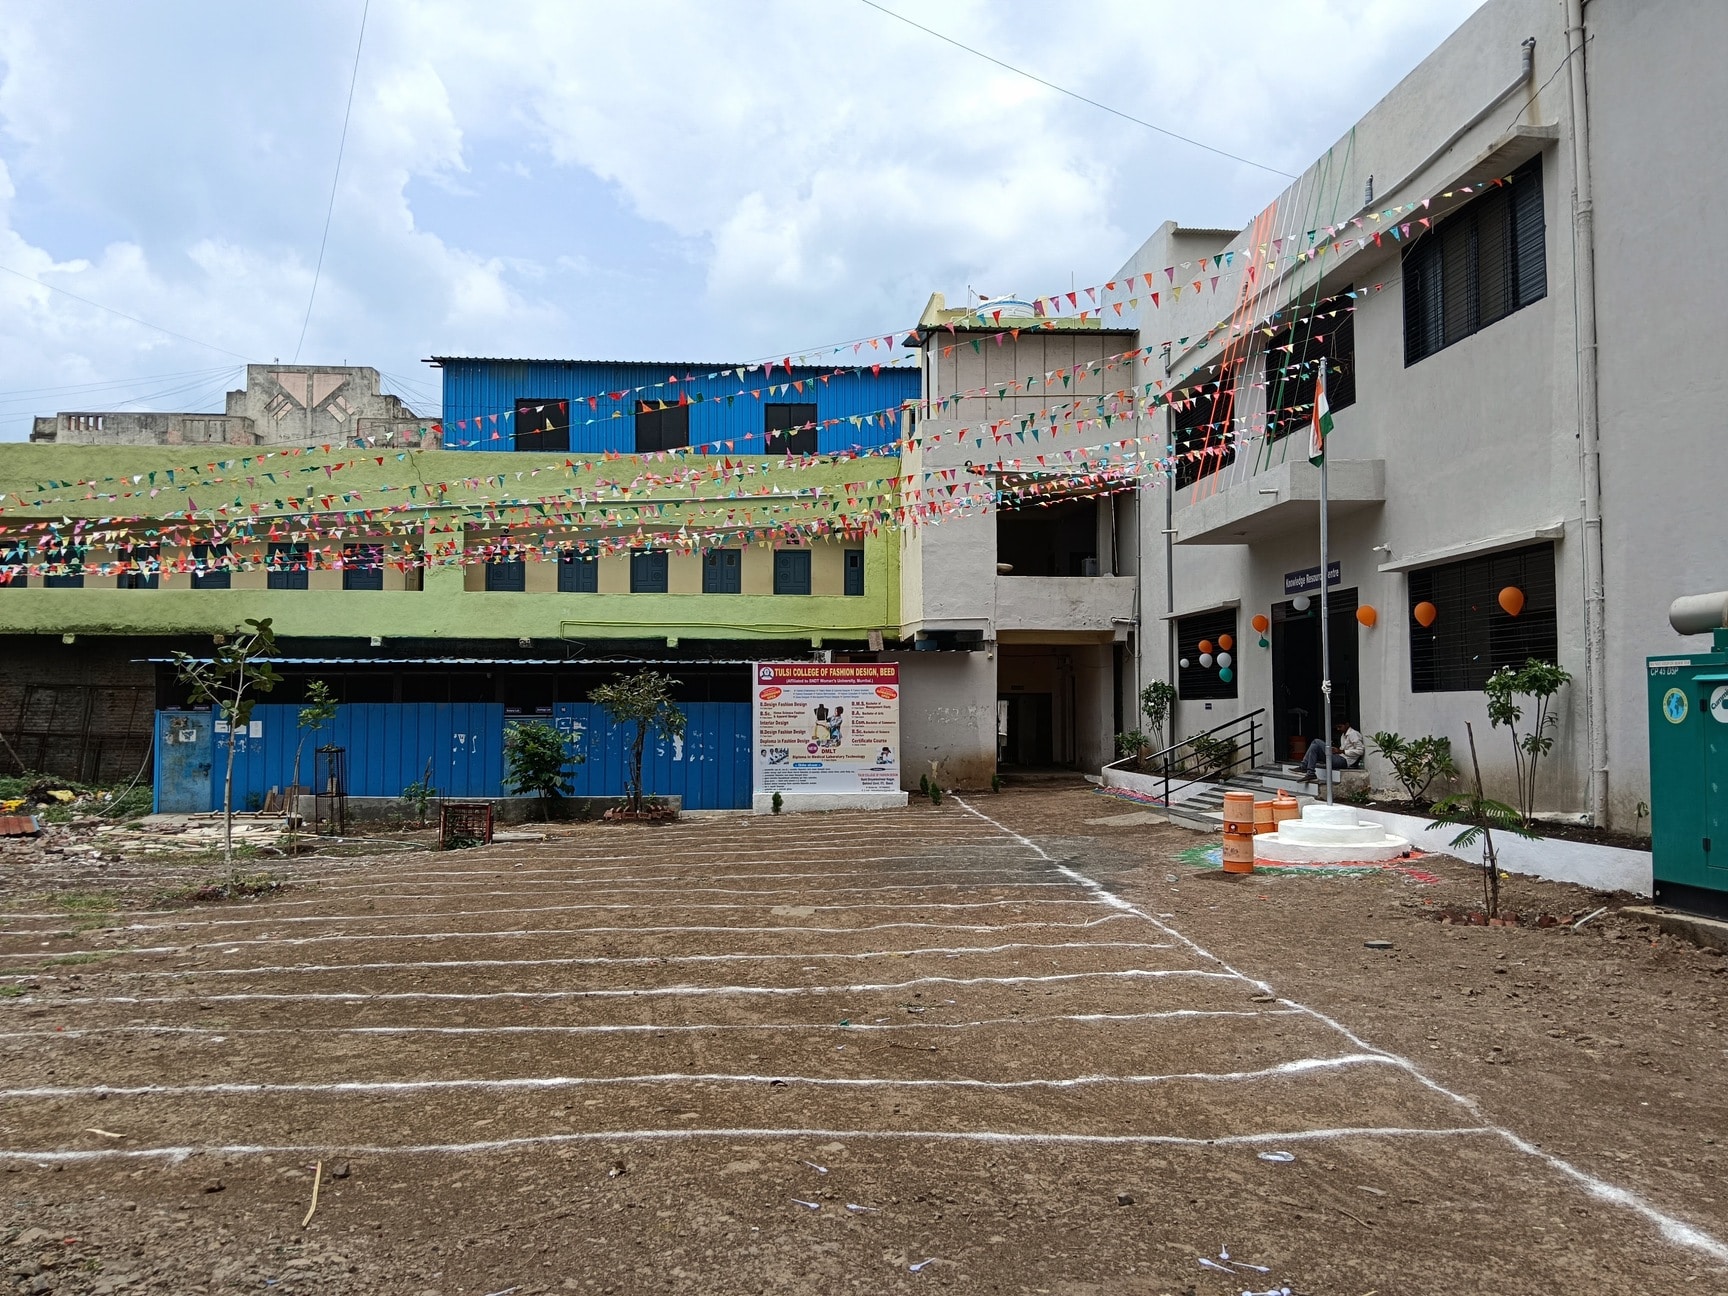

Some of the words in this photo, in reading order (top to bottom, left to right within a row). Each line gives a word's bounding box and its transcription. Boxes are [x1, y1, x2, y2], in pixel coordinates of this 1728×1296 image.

[1286, 576, 1306, 588] Knowledge
[1328, 568, 1339, 578] entre
[774, 668, 792, 676] TULSI
[793, 668, 820, 676] COLLEGE
[820, 668, 828, 676] OF
[830, 668, 854, 676] FASHION
[856, 668, 879, 678] DESIGN,
[880, 668, 895, 676] BEED
